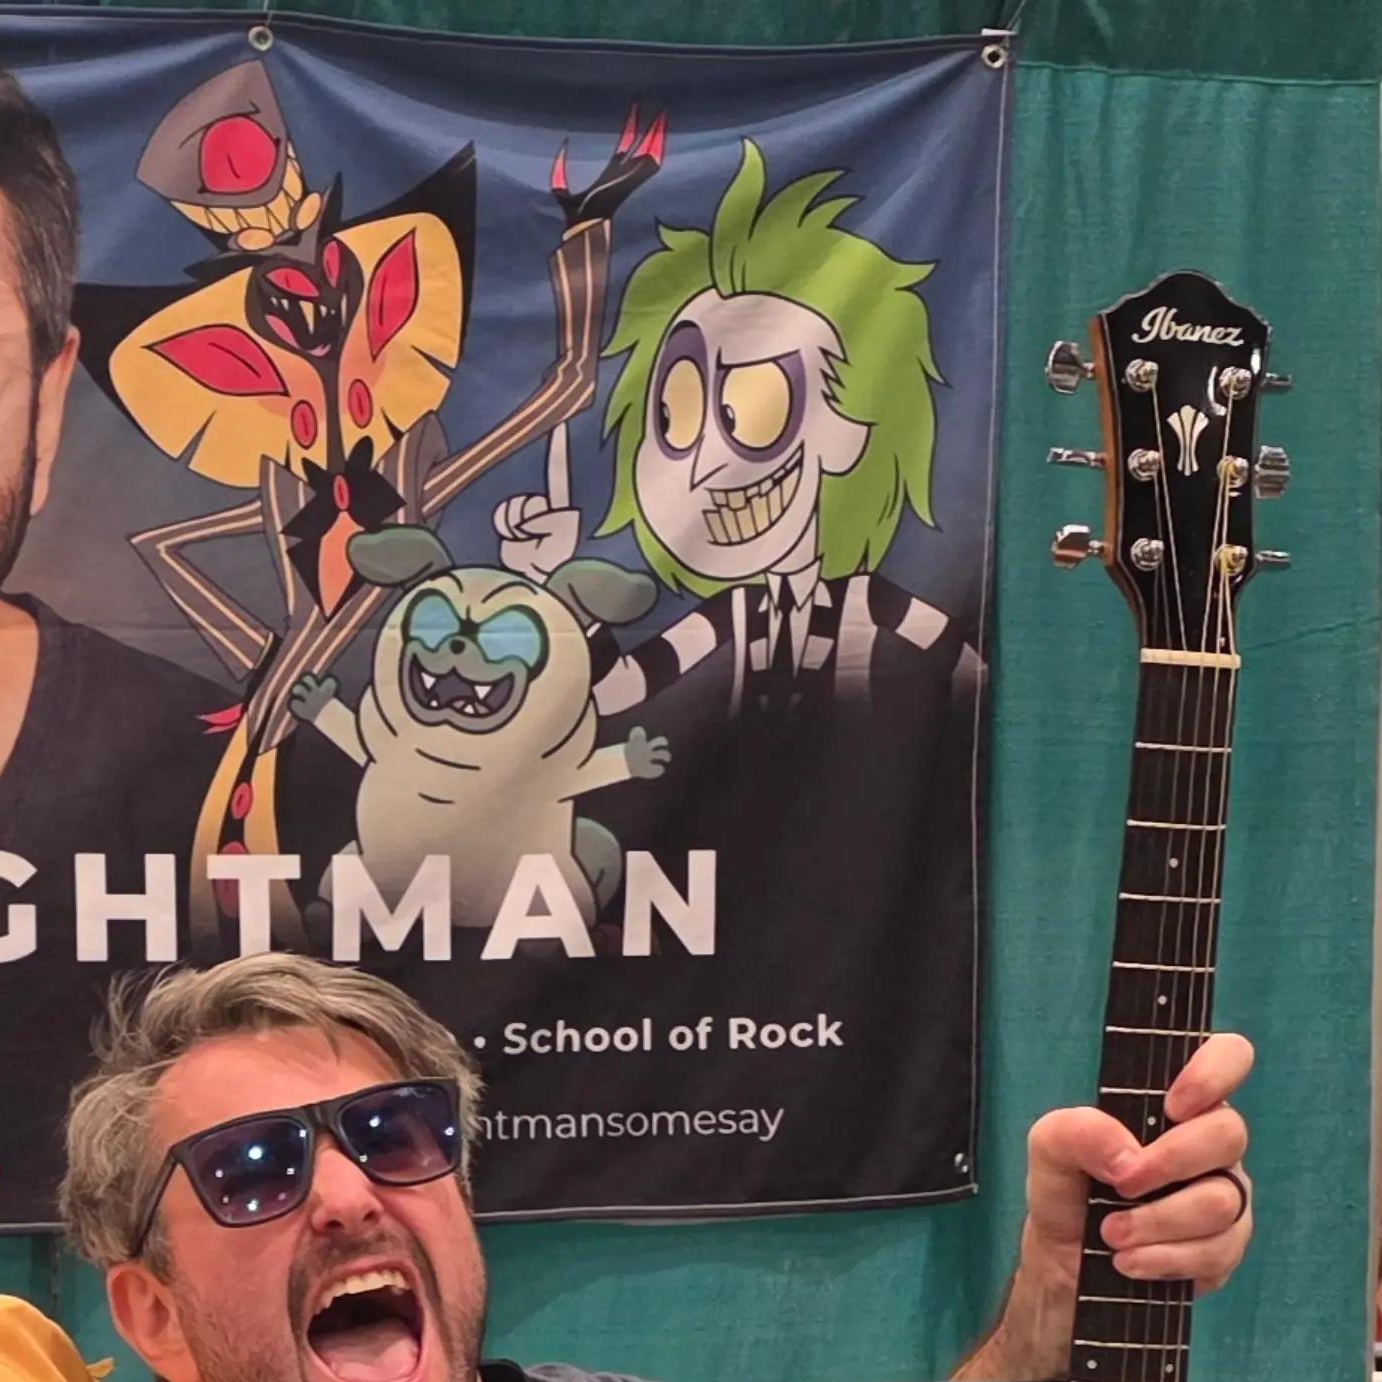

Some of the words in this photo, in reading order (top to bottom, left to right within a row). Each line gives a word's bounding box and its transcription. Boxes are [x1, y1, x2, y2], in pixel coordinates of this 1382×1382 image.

[1131, 306, 1245, 346] Ibanez
[503, 1017, 653, 1055] School
[668, 1016, 714, 1051] of
[728, 1013, 845, 1050] Rock
